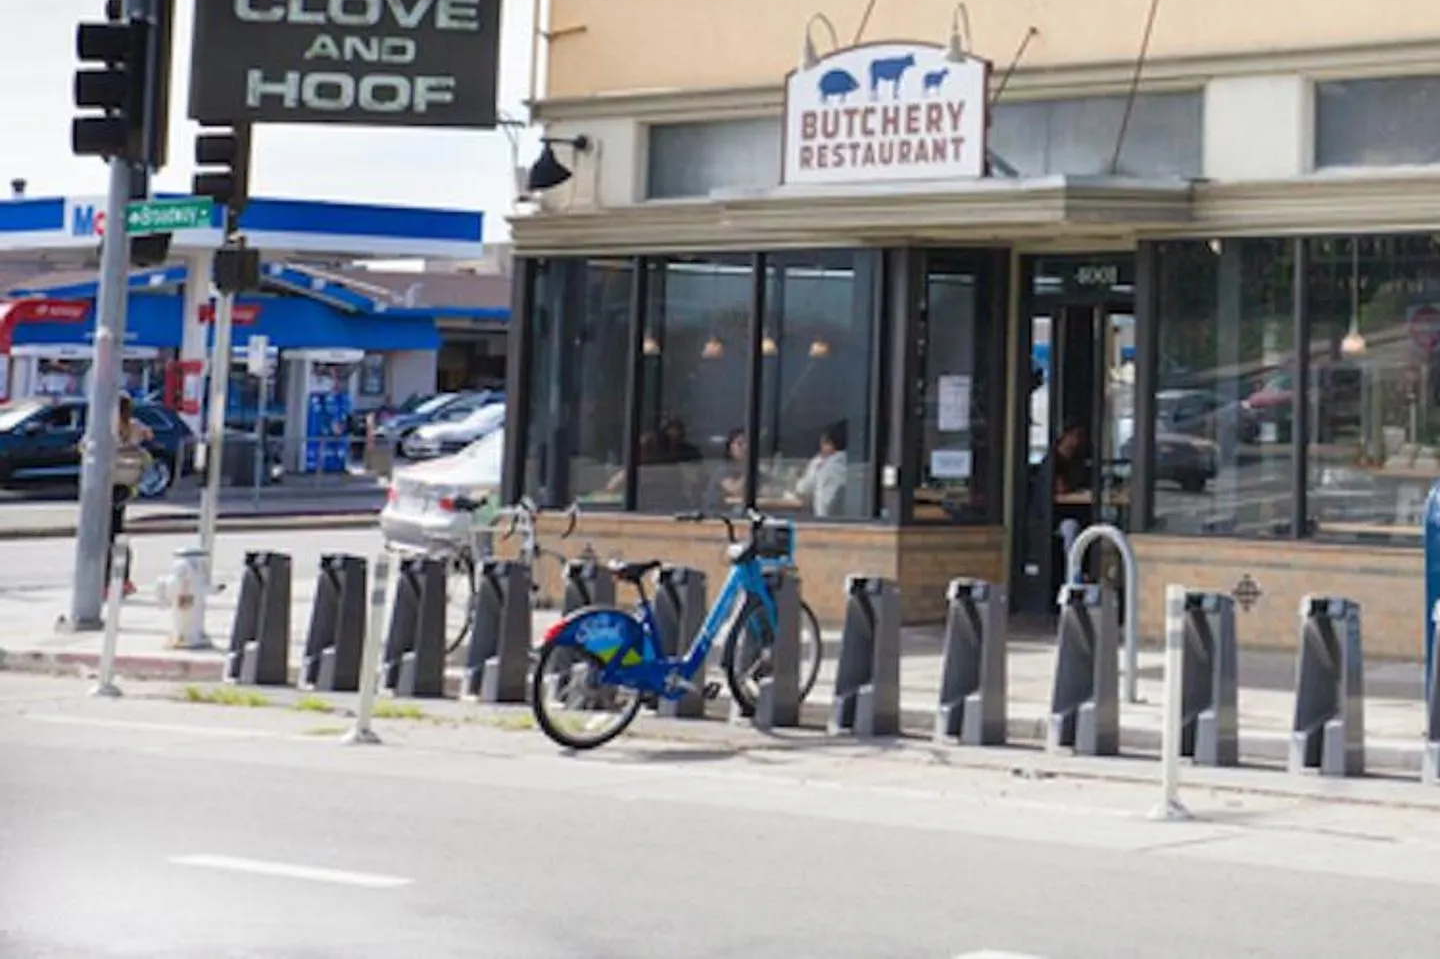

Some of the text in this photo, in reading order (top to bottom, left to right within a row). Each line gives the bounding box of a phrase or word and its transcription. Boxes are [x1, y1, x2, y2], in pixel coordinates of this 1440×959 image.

[303, 33, 417, 64] AND
[245, 69, 457, 113] HOOF
[800, 101, 966, 141] BUTCHERY
[799, 137, 966, 169] RESTAURANT
